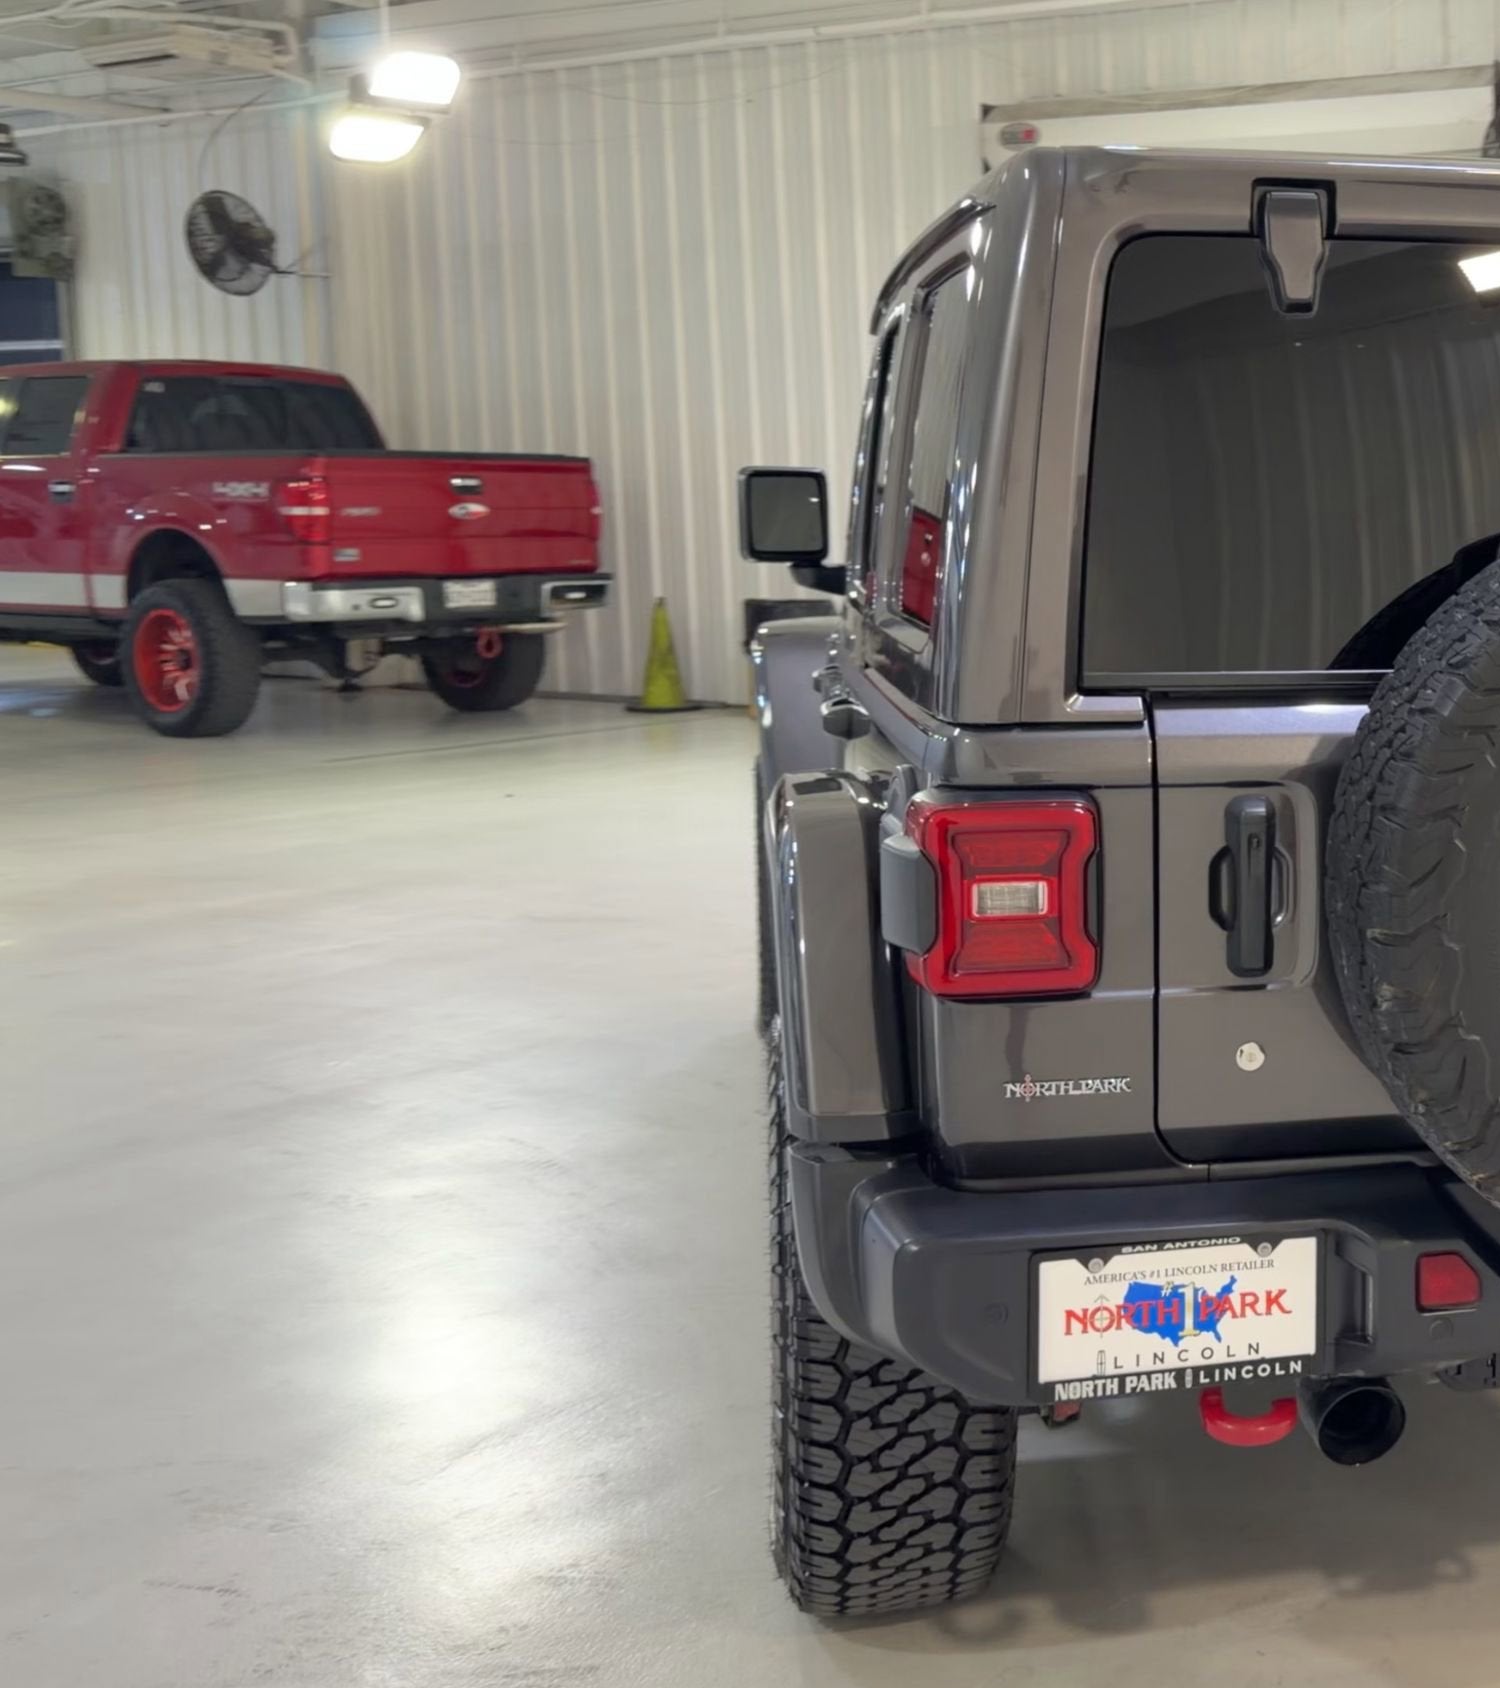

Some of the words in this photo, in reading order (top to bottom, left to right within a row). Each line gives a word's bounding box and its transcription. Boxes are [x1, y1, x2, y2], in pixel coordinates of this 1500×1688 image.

[1003, 1078, 1074, 1100] NORTH
[1078, 1077, 1132, 1095] PARK
[1121, 1243, 1158, 1254] SAN
[1163, 1236, 1242, 1250] ANTONIO
[1084, 1270, 1147, 1286] AMERICA'S
[1149, 1268, 1161, 1280] #1
[1164, 1262, 1219, 1278] LINCOLN
[1220, 1258, 1275, 1273] RETAILER
[1064, 1298, 1180, 1336] NORTH
[1199, 1288, 1292, 1322] PARK
[1113, 1342, 1261, 1369] LINCOLN
[1054, 1377, 1119, 1402] NORTH
[1125, 1371, 1177, 1394] PARK
[1199, 1360, 1302, 1383] LINCOLN
